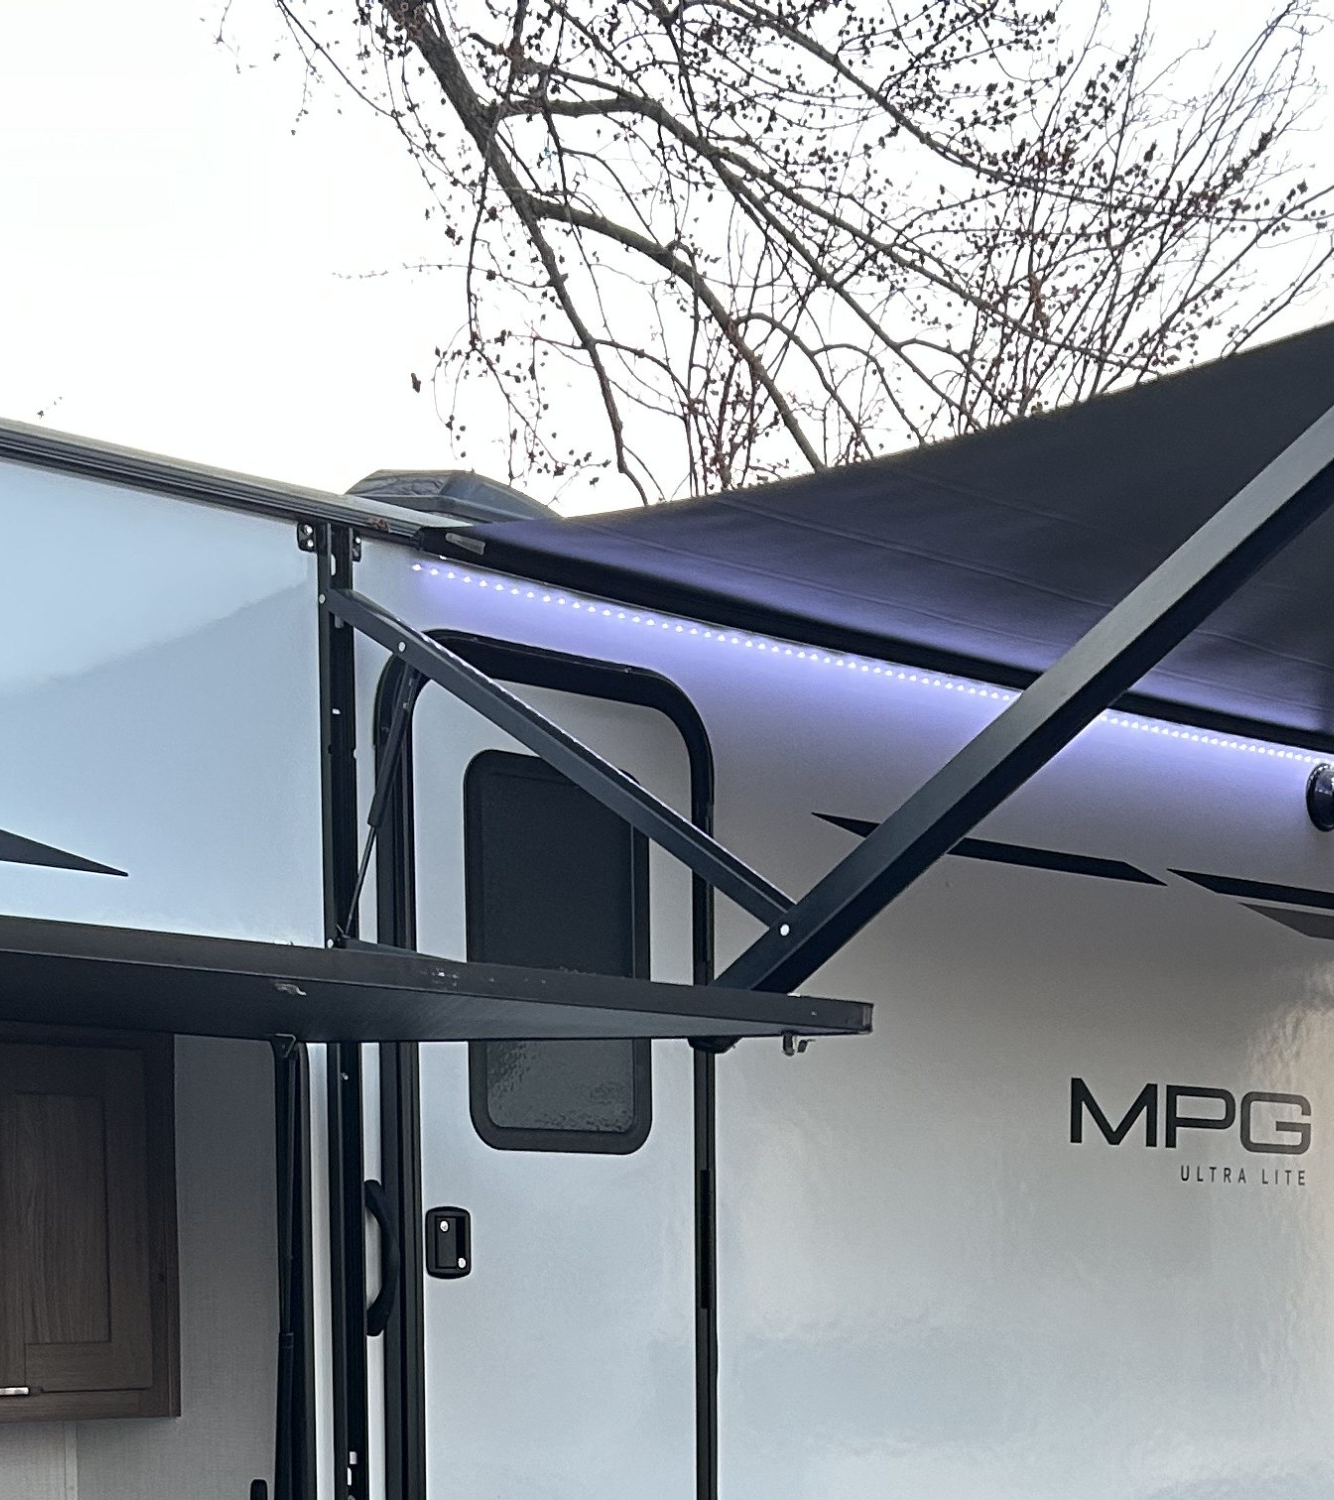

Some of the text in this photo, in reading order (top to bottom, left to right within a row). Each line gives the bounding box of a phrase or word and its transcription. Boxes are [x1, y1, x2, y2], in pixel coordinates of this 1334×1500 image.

[1070, 1077, 1312, 1155] MPG
[1179, 1164, 1306, 1186] ULTRA LITE
